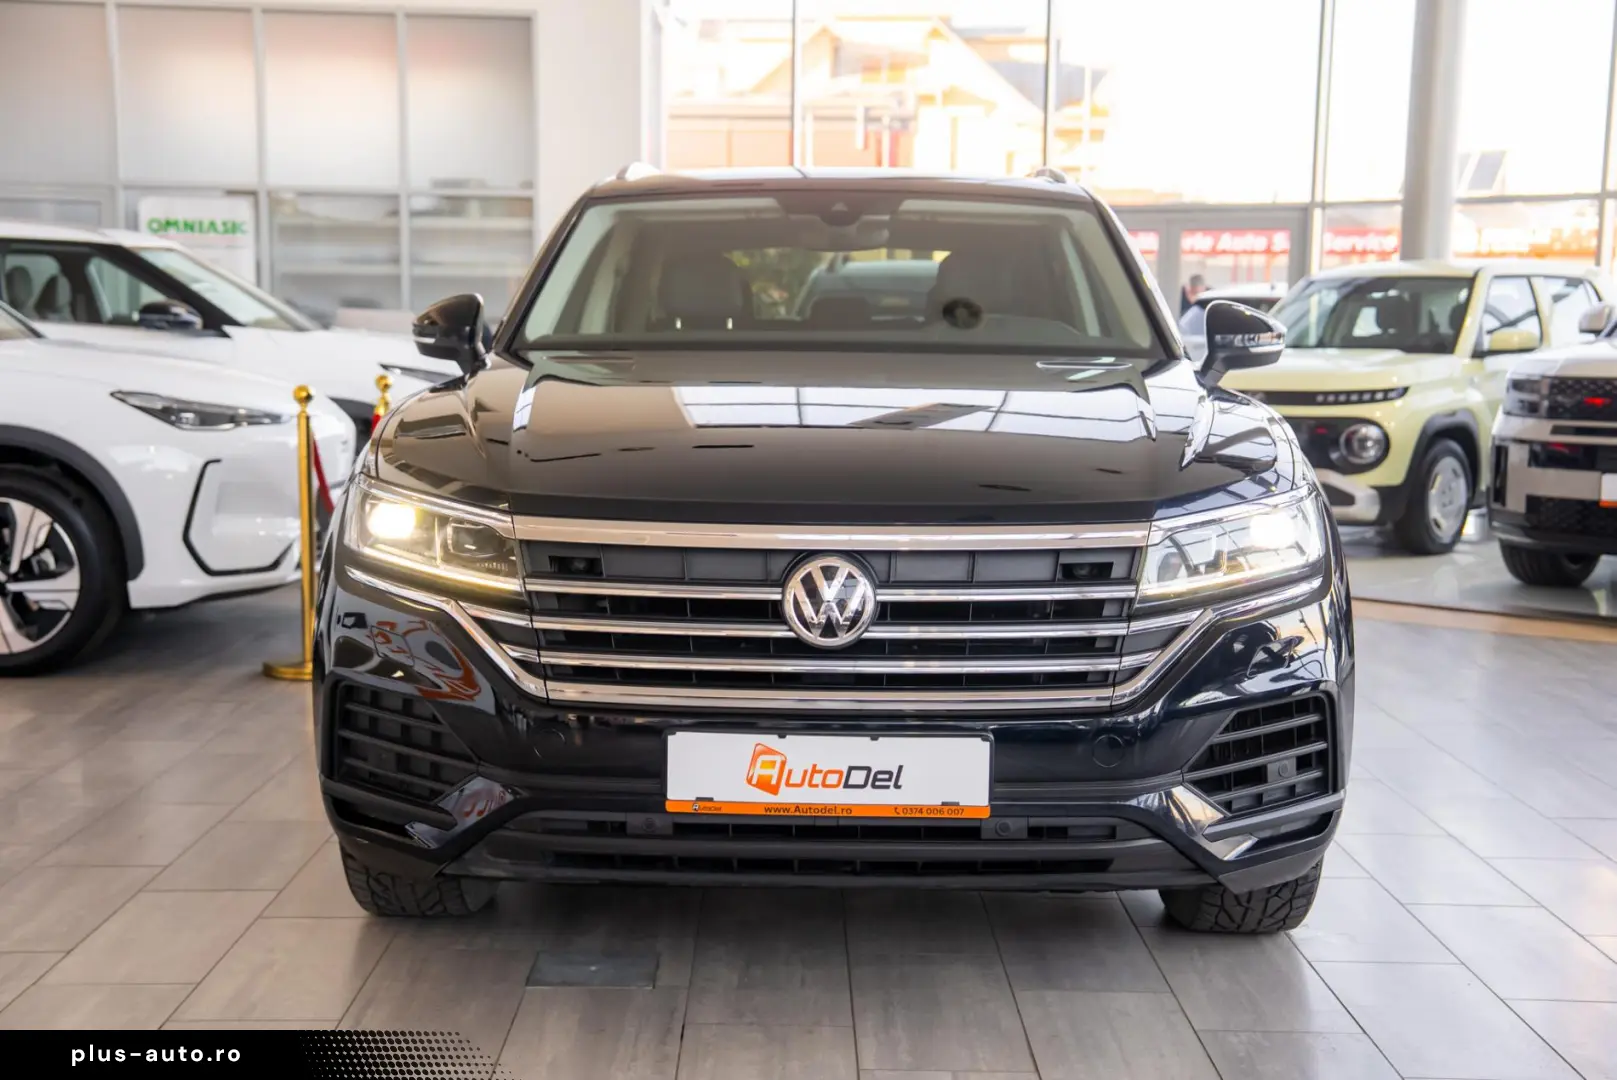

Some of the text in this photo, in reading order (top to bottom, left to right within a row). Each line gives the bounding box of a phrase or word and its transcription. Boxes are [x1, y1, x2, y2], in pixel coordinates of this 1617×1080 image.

[749, 751, 904, 791] AutoDel
[764, 804, 853, 816] www.Autodel.ro
[902, 806, 965, 817] 0374 006 007
